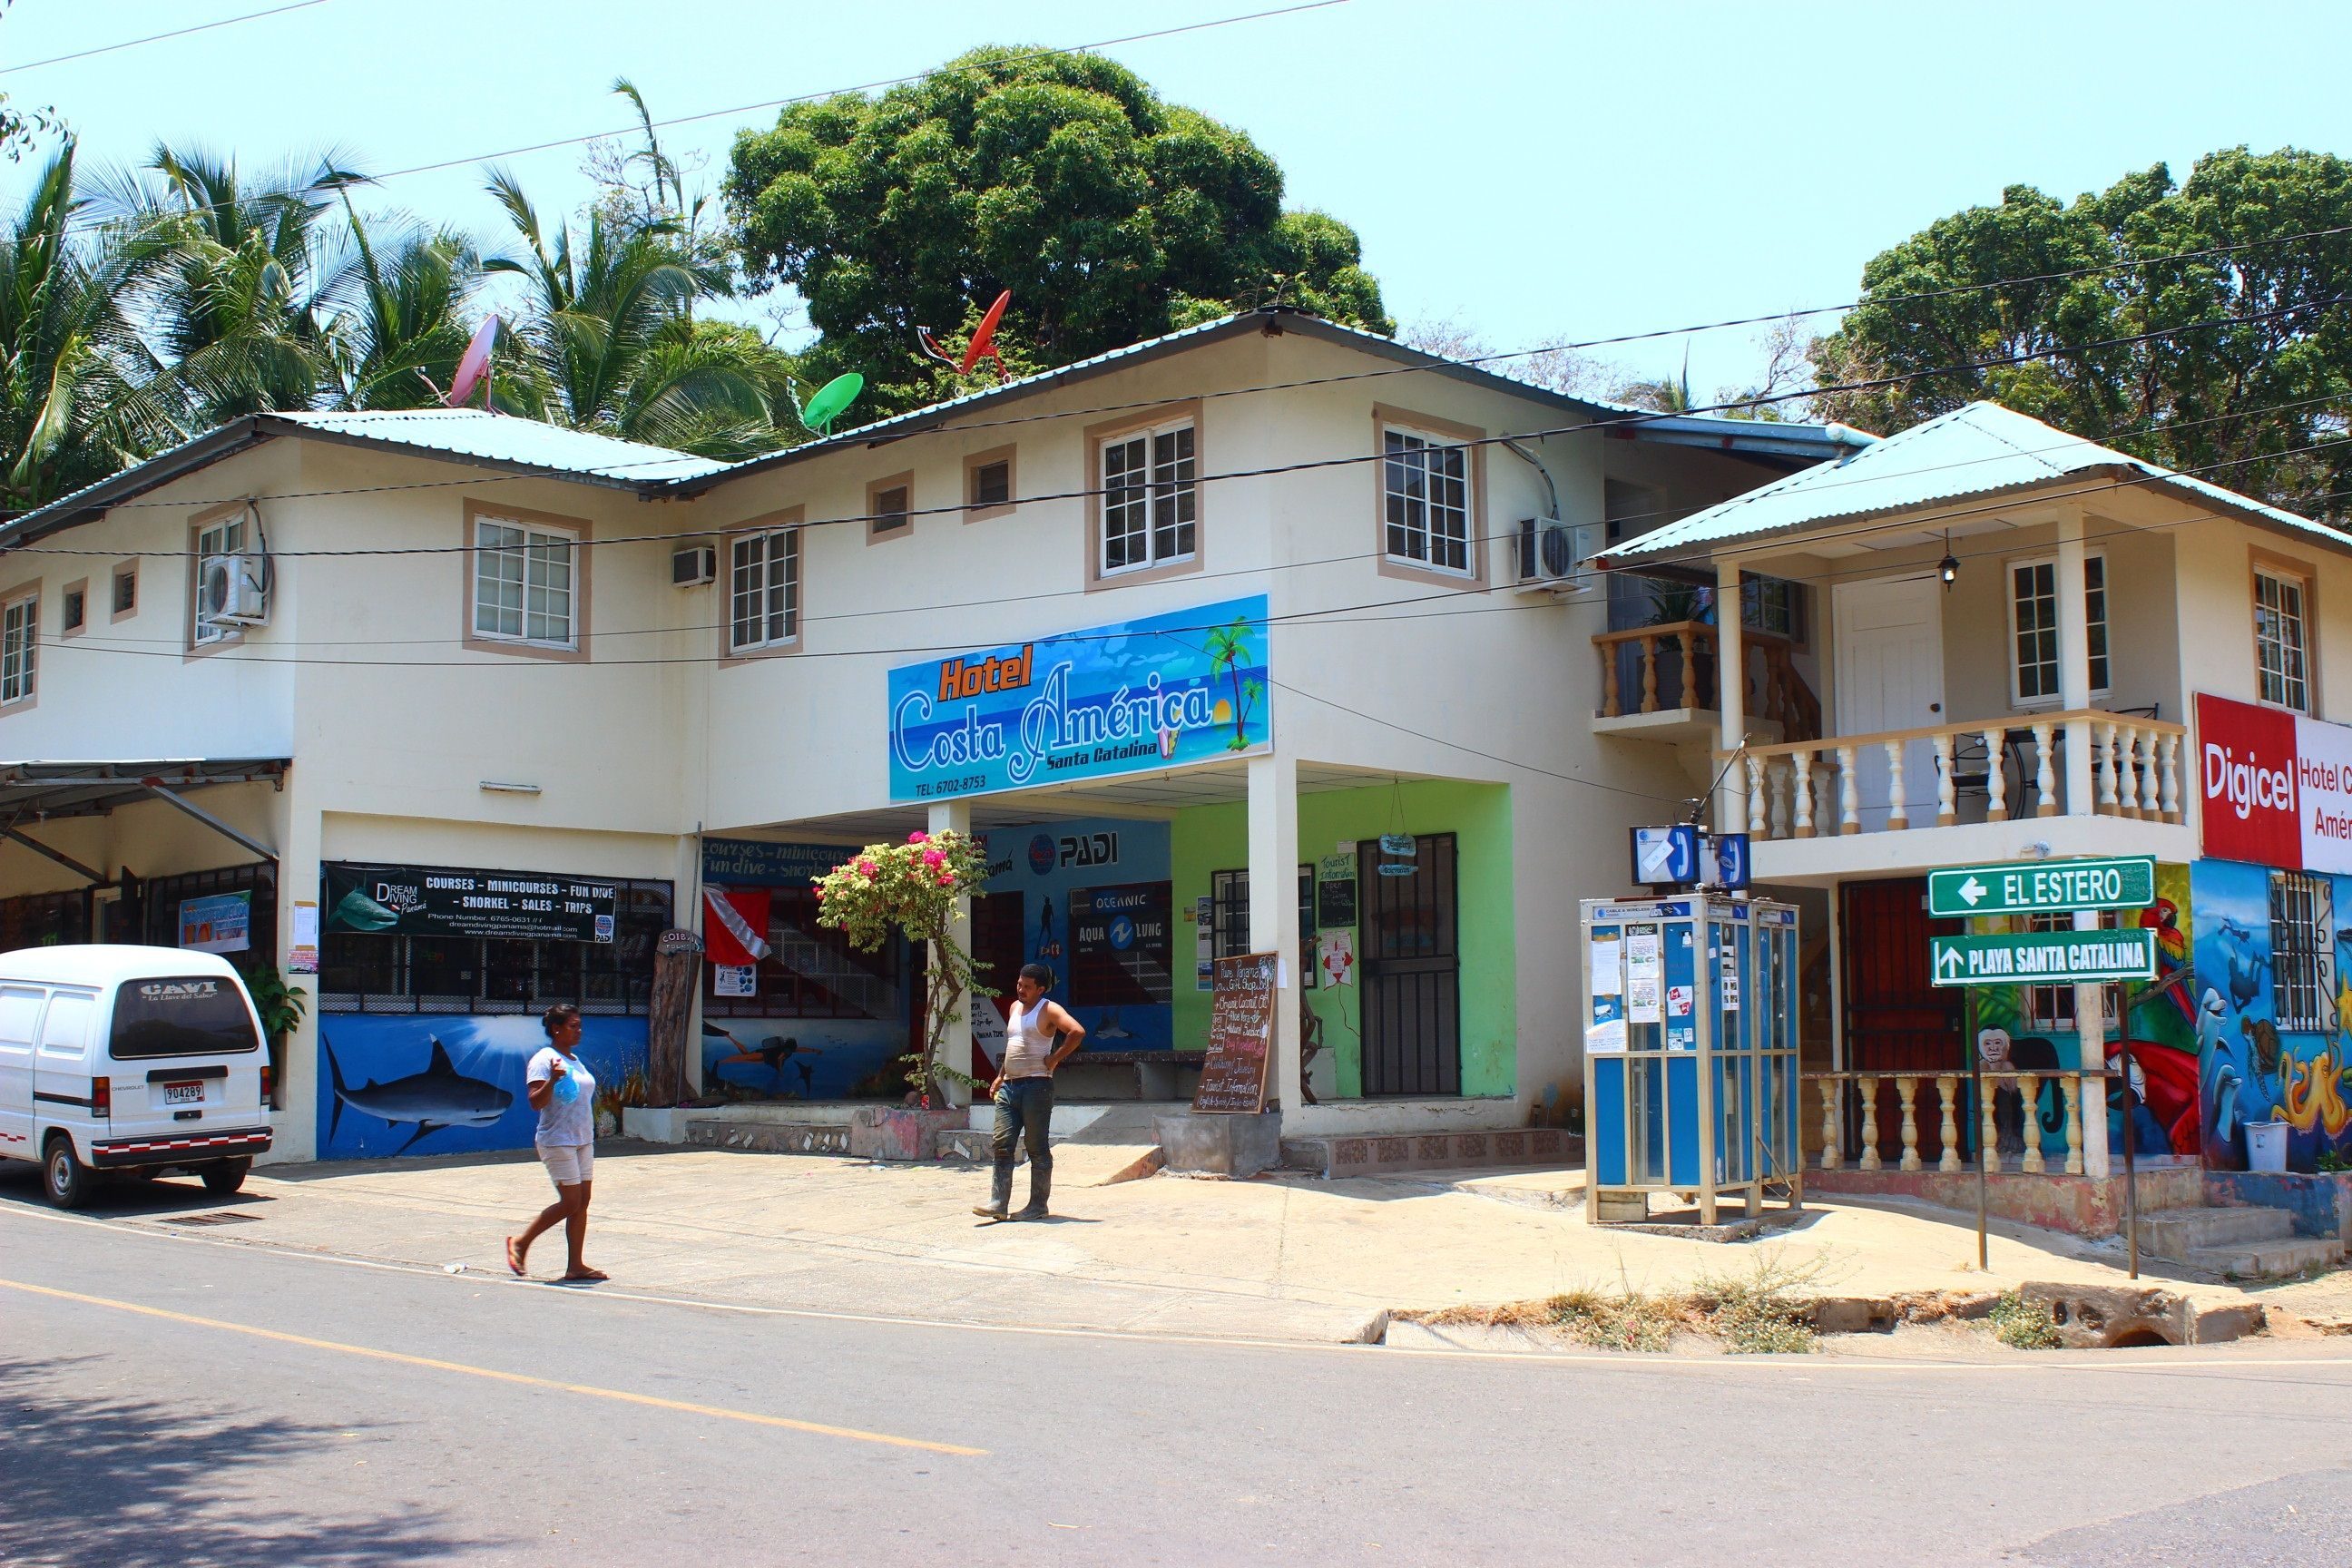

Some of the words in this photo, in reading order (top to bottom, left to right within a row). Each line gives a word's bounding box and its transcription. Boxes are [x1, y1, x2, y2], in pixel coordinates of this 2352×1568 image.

[937, 643, 1034, 702] Hotel
[894, 690, 1005, 772] Costa
[1007, 661, 1213, 784] América
[1047, 752, 1089, 770] Santa
[1093, 740, 1157, 763] Catalina
[2206, 742, 2294, 819] Digicel
[2299, 757, 2338, 792] Hotel
[916, 785, 934, 797] TEL:
[936, 775, 986, 793] 6702-8753
[1060, 831, 1118, 868] PADI
[732, 857, 767, 875] dive
[426, 877, 475, 890] COURSES
[487, 879, 559, 895] MINICOURSES
[570, 885, 589, 897] FUN
[593, 887, 614, 899] DIVE
[2004, 875, 2030, 906] EL
[2034, 868, 2122, 904] ESTERO
[463, 896, 509, 909] SNORKEL
[521, 898, 552, 911] SALES
[564, 901, 593, 914] TRIPS
[1096, 894, 1146, 908] OCEANIC
[449, 921, 577, 933] dreamdivingpanama@hotmailcom
[465, 928, 576, 939] www.dreamdivingpanamacom
[595, 934, 612, 942] PADI
[1079, 926, 1104, 943] AQUA
[1135, 923, 1161, 937] LUNG
[1968, 947, 2014, 975] PLAYA
[2016, 946, 2067, 972] SANTA
[2068, 942, 2145, 971] CATALINA
[141, 982, 218, 995] CAVI
[167, 1086, 201, 1099] 904289
